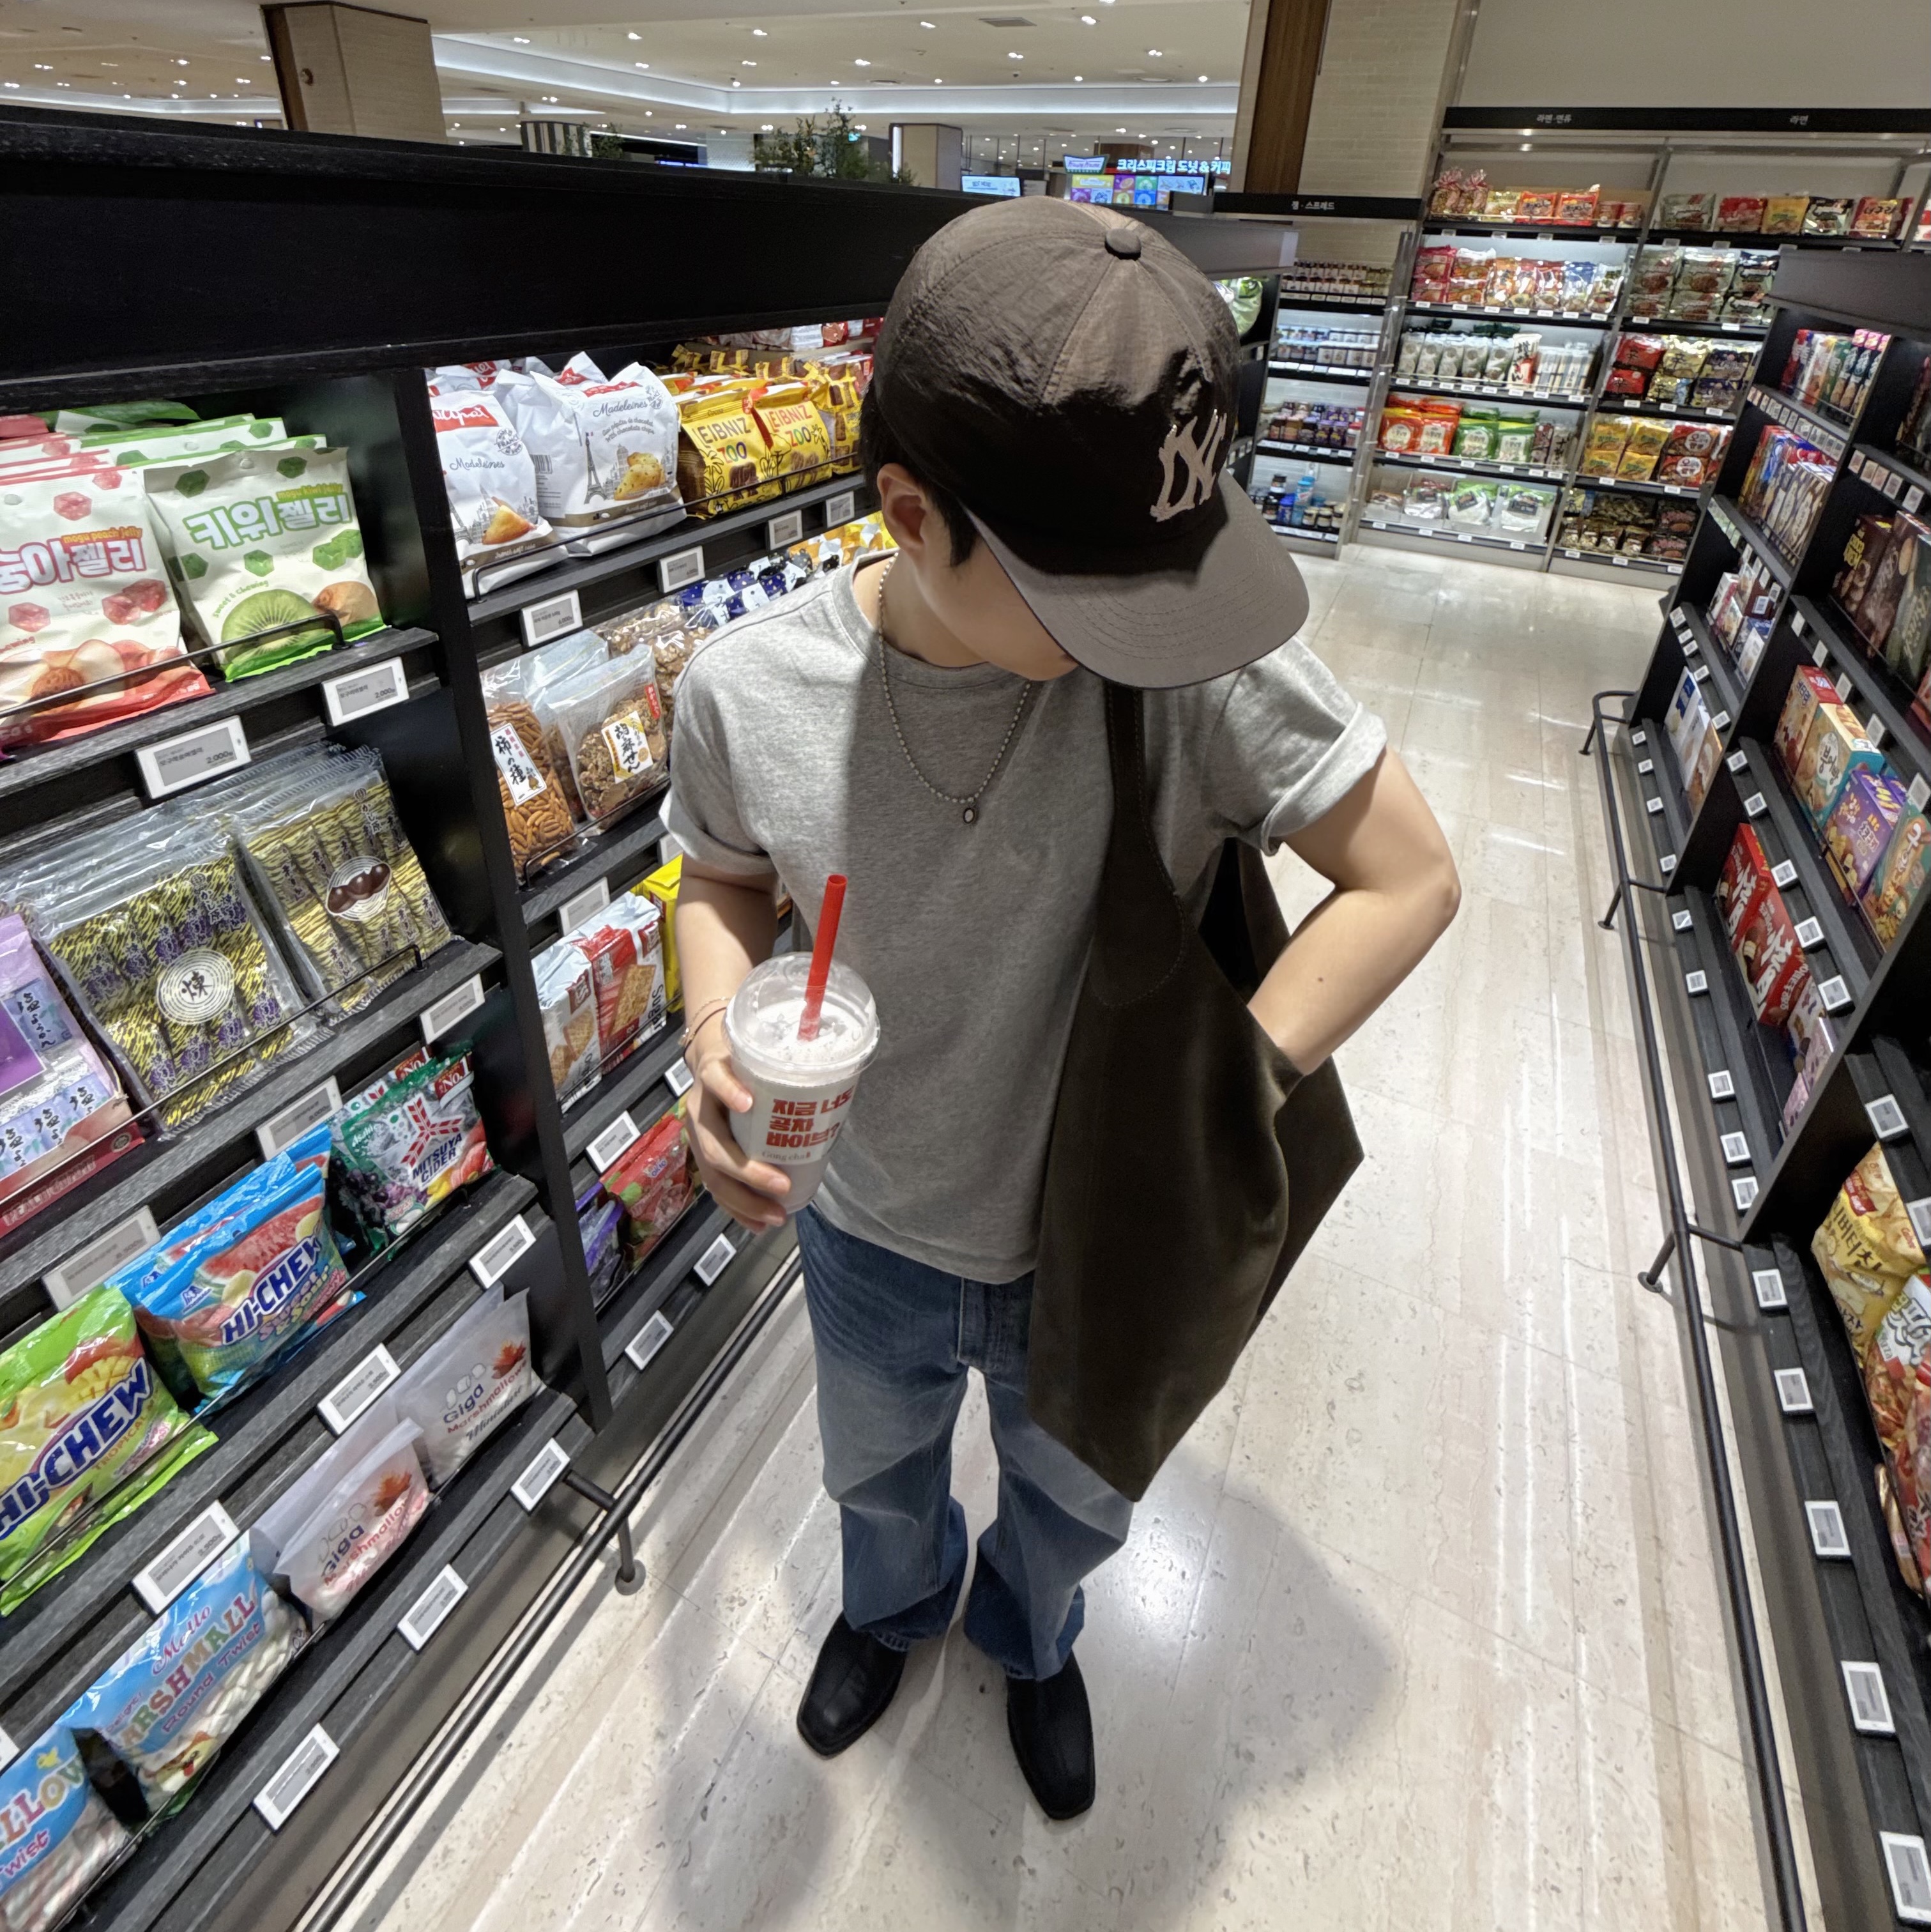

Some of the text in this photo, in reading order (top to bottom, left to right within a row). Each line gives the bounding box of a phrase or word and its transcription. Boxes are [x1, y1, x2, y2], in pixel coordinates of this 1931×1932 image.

[1118, 159, 1231, 174] 크리스피크림 도넛 & 커피
[593, 399, 647, 417] Madeleines
[765, 401, 813, 433] LEIBNIZ
[691, 417, 752, 448] LEIBNIZ
[785, 426, 811, 448] ZOO
[450, 457, 505, 471] Madeleines
[717, 441, 747, 464] ZOO
[62, 532, 89, 544] mogu
[92, 528, 119, 540] peach
[183, 492, 352, 550] 키위젤리
[496, 735, 526, 785] 柿の種
[440, 1055, 470, 1092] No.1
[772, 1098, 817, 1116] 지금
[353, 1126, 376, 1147] Asahi
[766, 1122, 841, 1148] 바이브?
[770, 1115, 814, 1132] 공차
[412, 1133, 462, 1180] MITSUYA
[421, 1148, 456, 1183] CIDER
[443, 1383, 484, 1424] Giga
[448, 1360, 526, 1433] Marshmallows
[95, 1414, 145, 1469] TROPICAL
[322, 1524, 364, 1577] Giga
[152, 1606, 211, 1675] Mello
[162, 1621, 260, 1733] Round Twist
